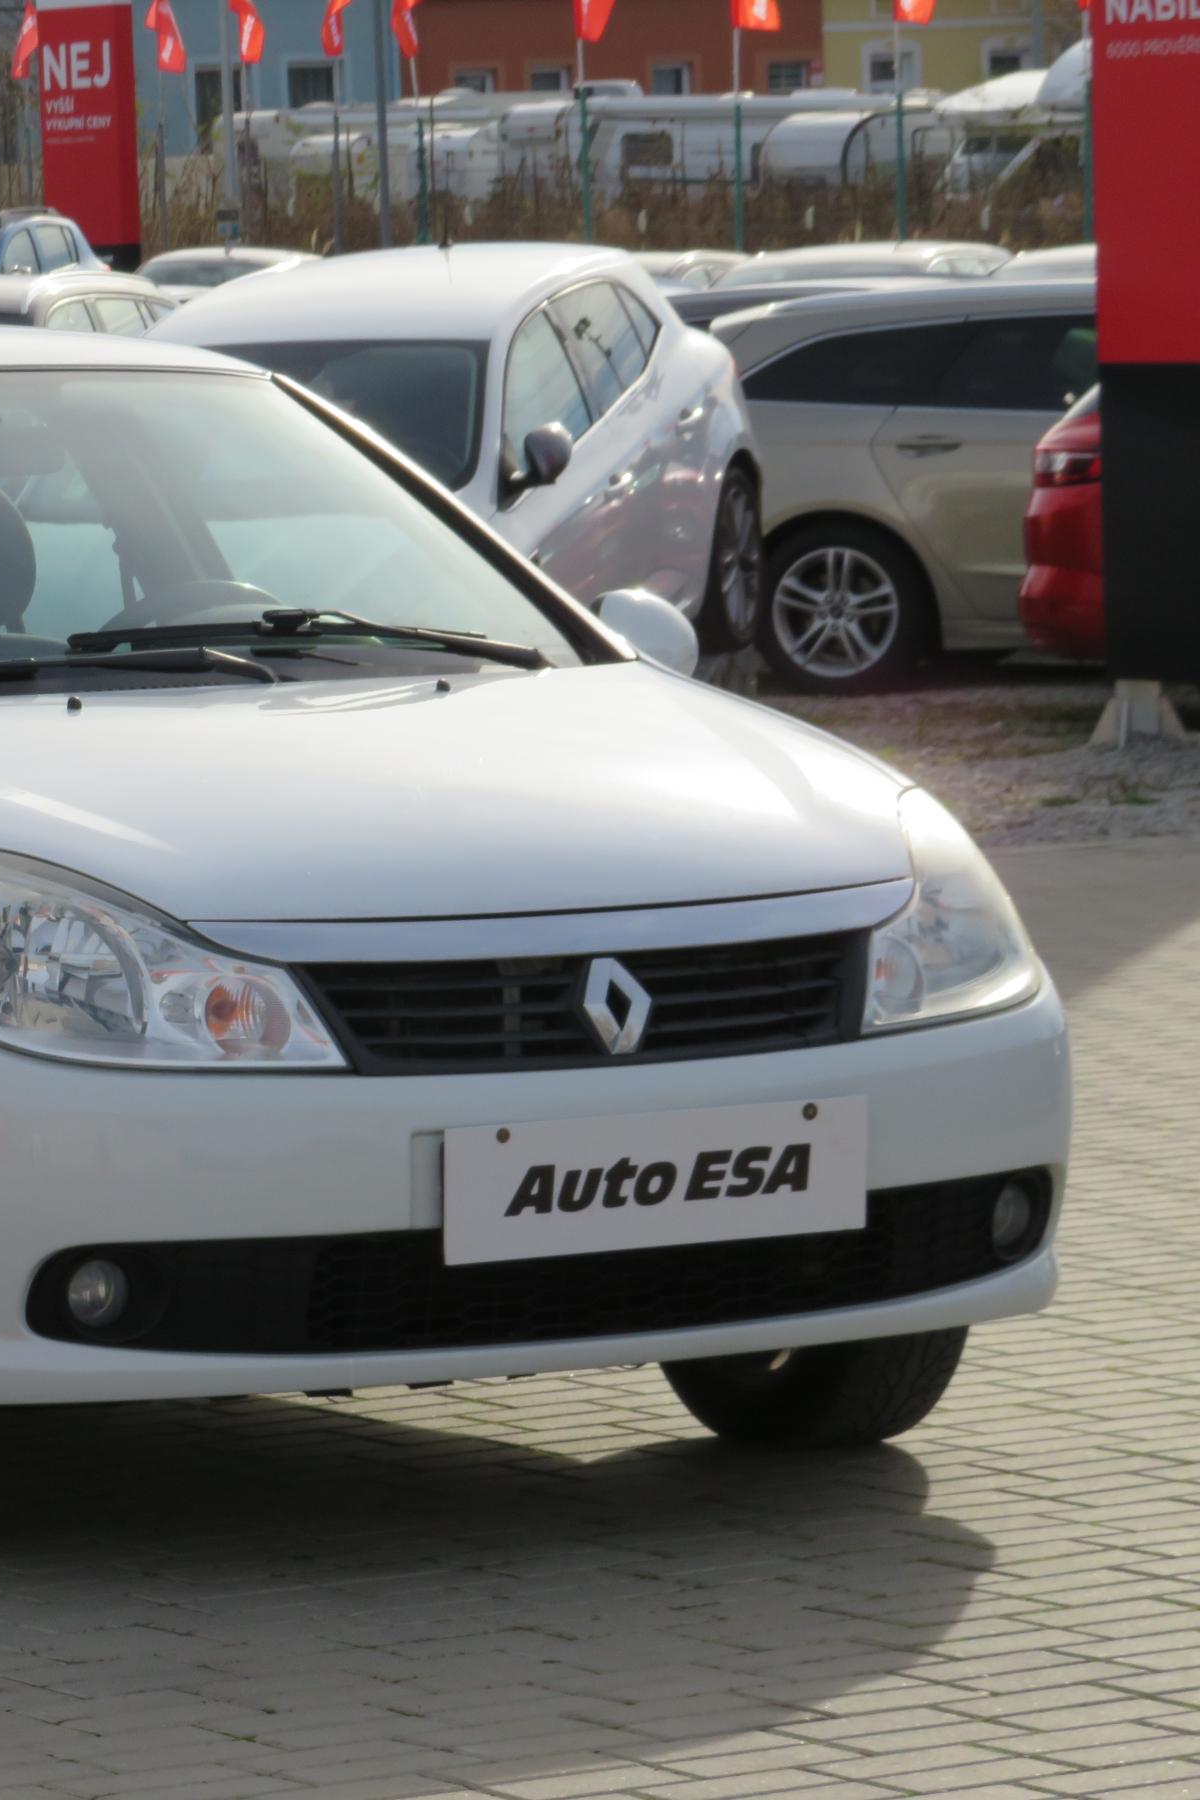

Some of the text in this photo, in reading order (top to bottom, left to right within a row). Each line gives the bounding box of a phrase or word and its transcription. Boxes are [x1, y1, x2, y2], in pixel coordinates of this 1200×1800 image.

[43, 40, 111, 91] NEJ
[87, 115, 112, 130] CENY
[503, 1143, 812, 1217] Auto ESA
